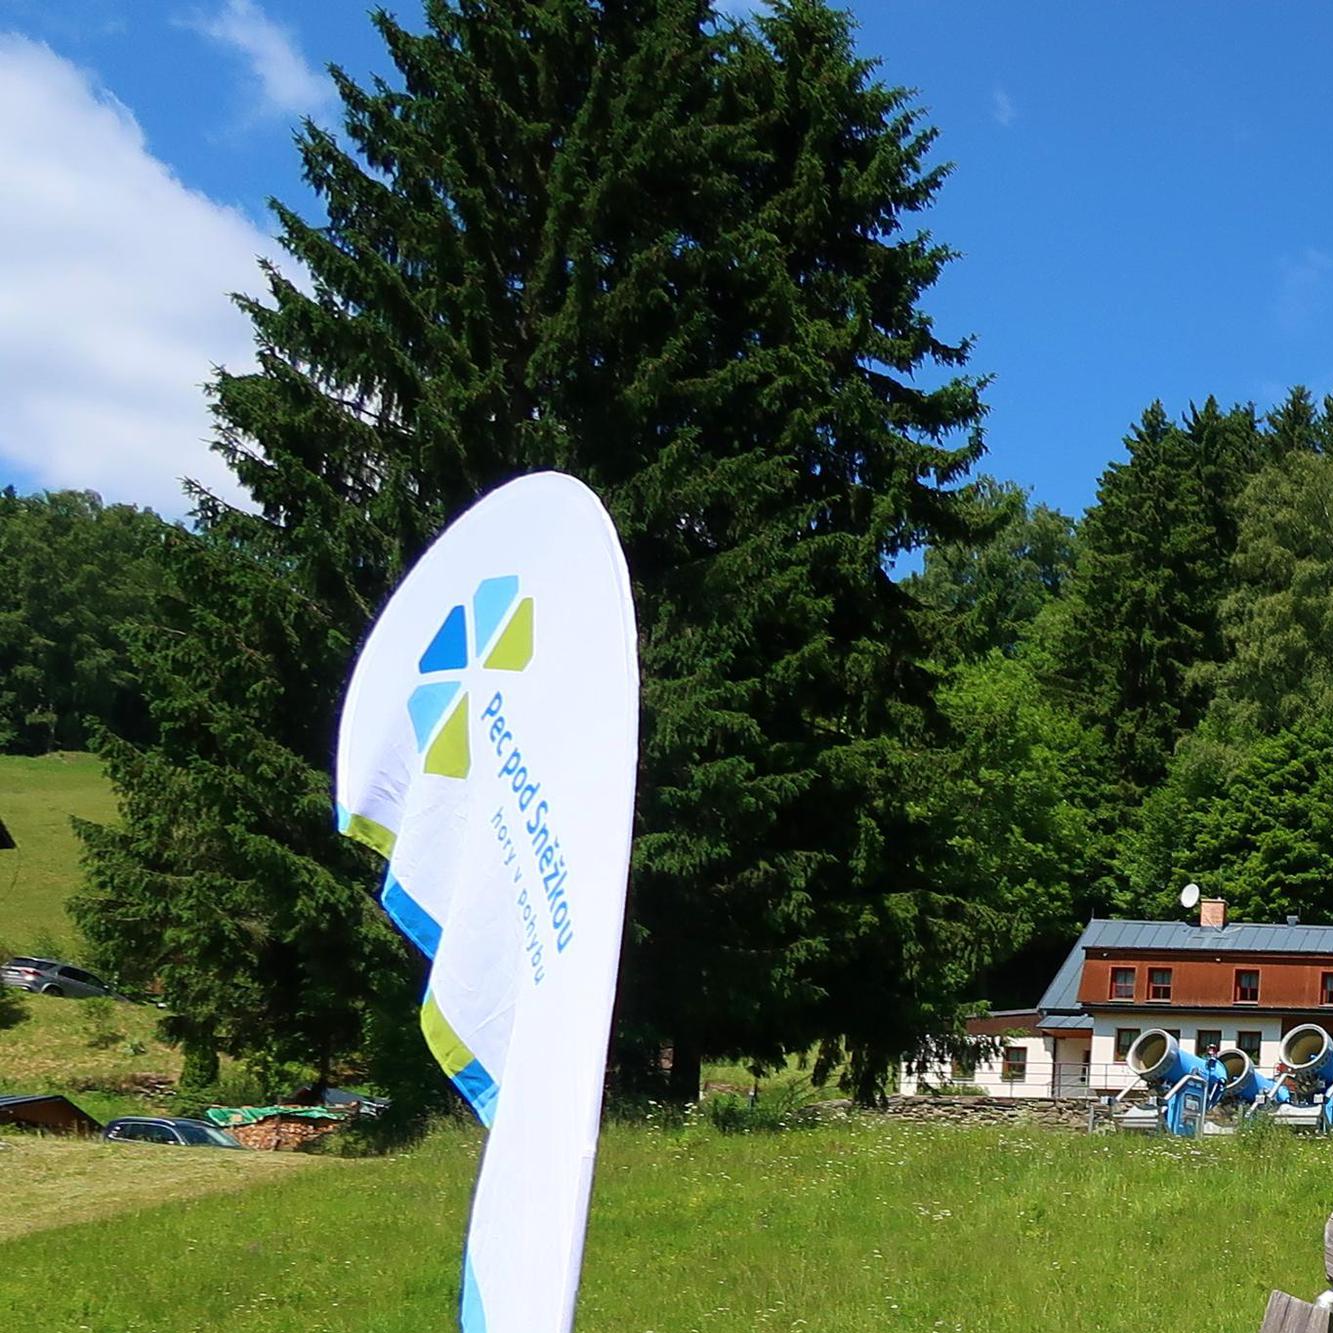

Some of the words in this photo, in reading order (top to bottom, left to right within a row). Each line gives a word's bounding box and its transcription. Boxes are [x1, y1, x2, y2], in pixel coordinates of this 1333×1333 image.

[480, 690, 513, 757] Pec
[497, 747, 541, 812] pod
[526, 799, 574, 954] Sněžkou
[490, 806, 517, 866] hory
[513, 866, 523, 884] v
[516, 888, 546, 986] pohybu
